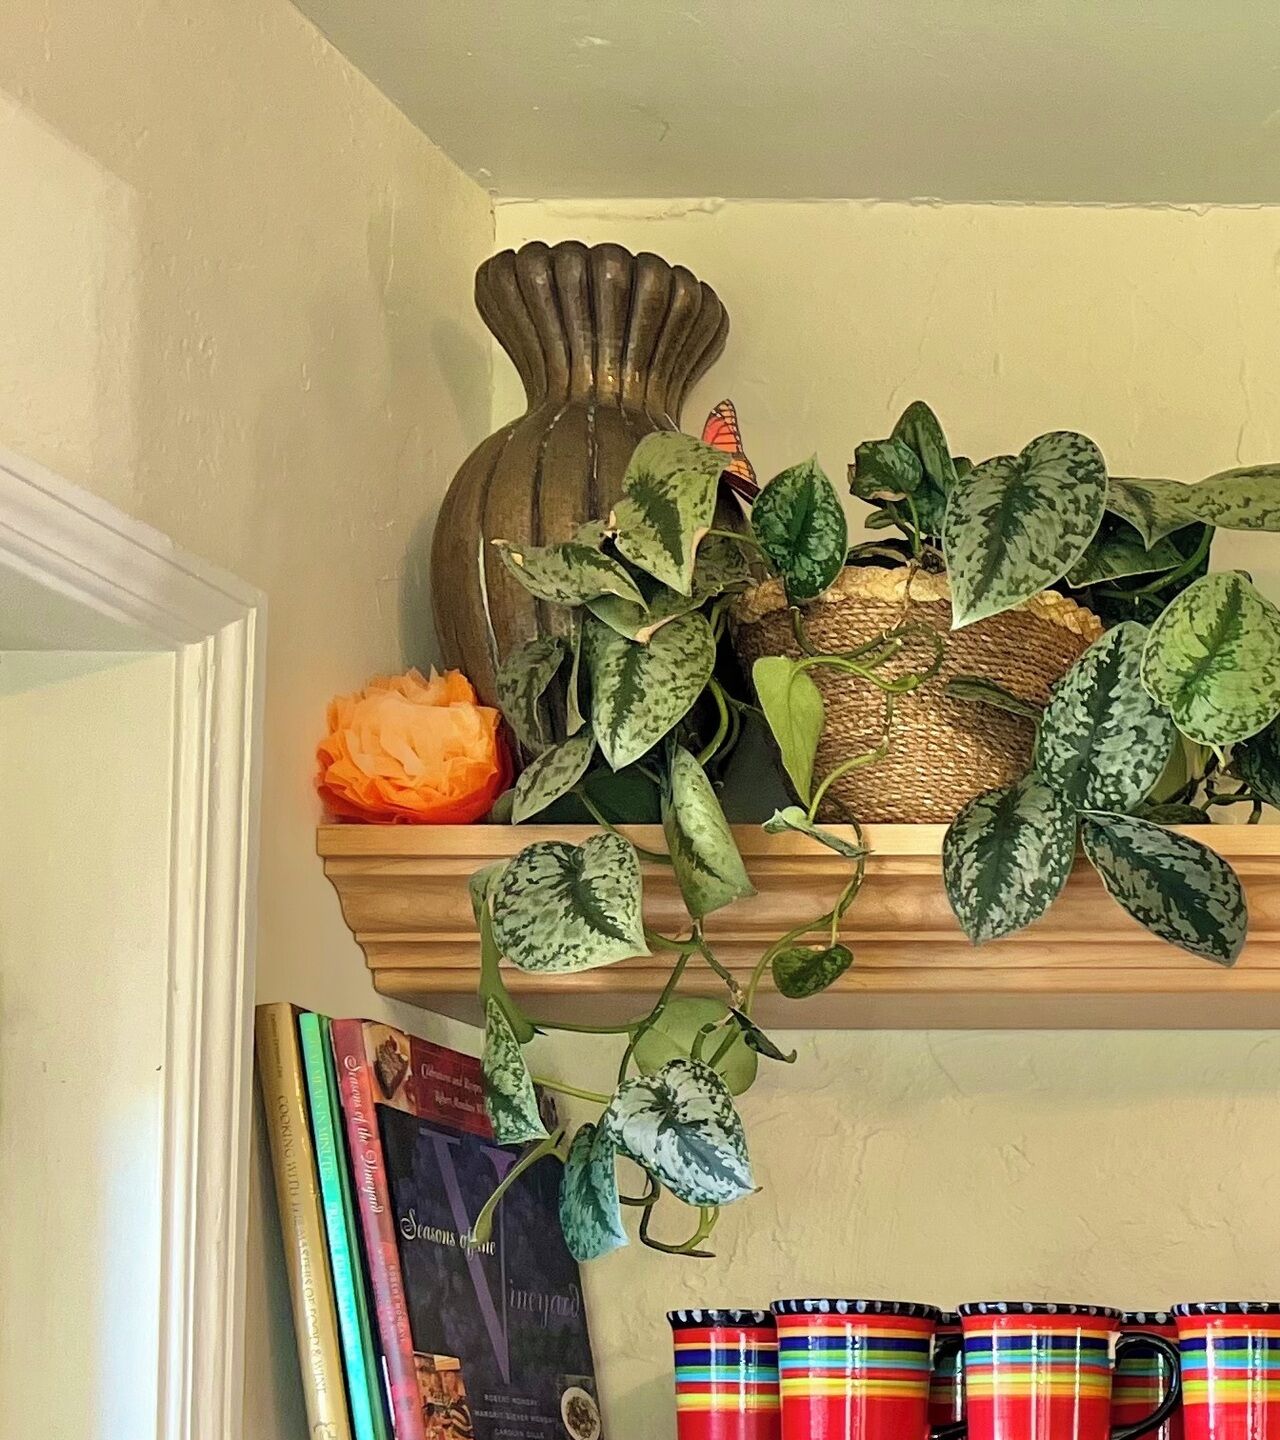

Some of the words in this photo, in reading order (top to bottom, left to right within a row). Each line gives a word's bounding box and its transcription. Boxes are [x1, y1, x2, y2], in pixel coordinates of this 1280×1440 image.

[344, 1055, 365, 1107] Seasons
[352, 1111, 365, 1125] of
[359, 1126, 373, 1142] the
[279, 1095, 294, 1158] COOKING
[287, 1161, 299, 1196] WITH
[360, 1150, 383, 1213] Vineyard
[400, 1208, 455, 1246] Seasons
